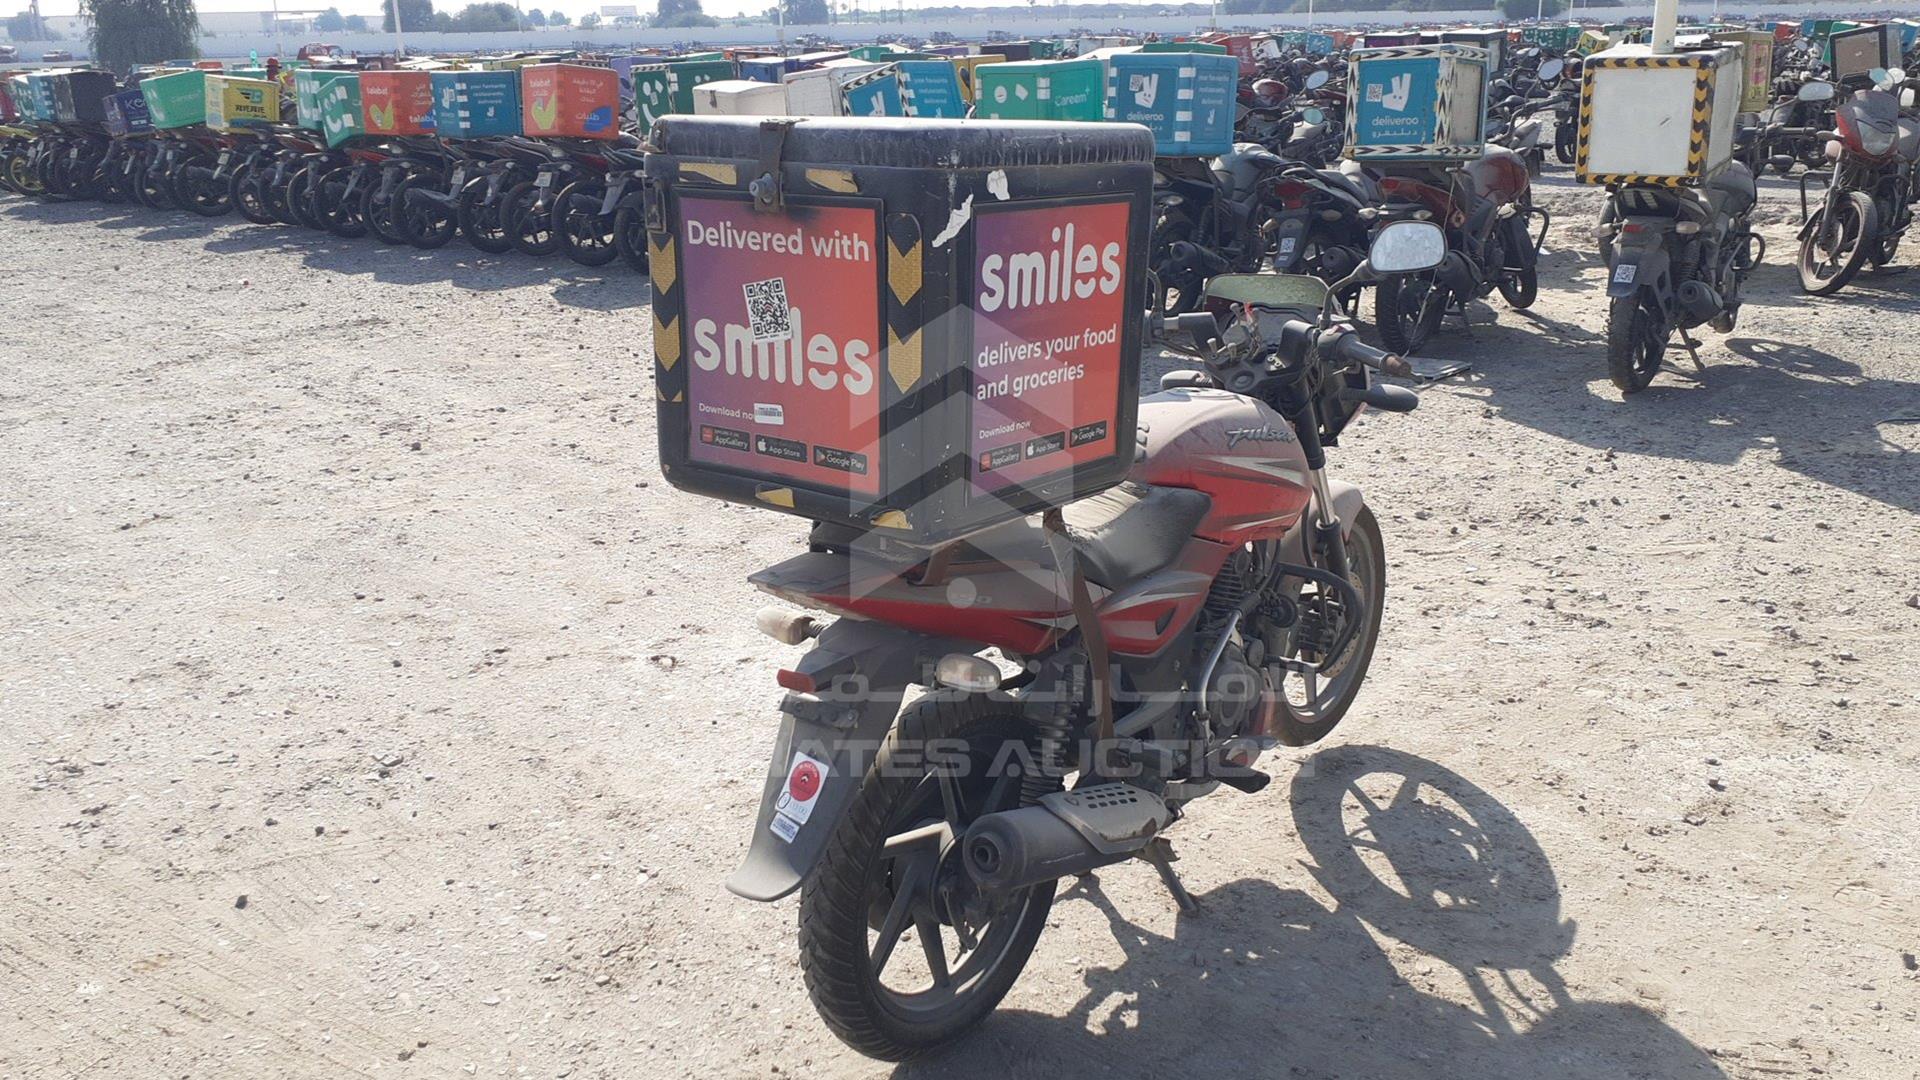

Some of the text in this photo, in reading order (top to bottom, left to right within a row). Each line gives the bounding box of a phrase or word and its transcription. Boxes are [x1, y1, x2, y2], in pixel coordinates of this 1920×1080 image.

[1126, 112, 1165, 122] deliveroo
[1372, 115, 1419, 127] deliveroo
[687, 219, 870, 262] Delivered with
[979, 222, 1121, 313] smiles
[694, 306, 874, 396] smiles
[977, 323, 1117, 368] delivers your food
[976, 361, 1085, 401] and groceries
[699, 402, 754, 421] Download no
[979, 420, 1031, 439] Download now
[714, 435, 749, 450] AppGallery
[768, 445, 782, 456] App
[783, 446, 801, 458] Store
[826, 454, 865, 471] Google Play
